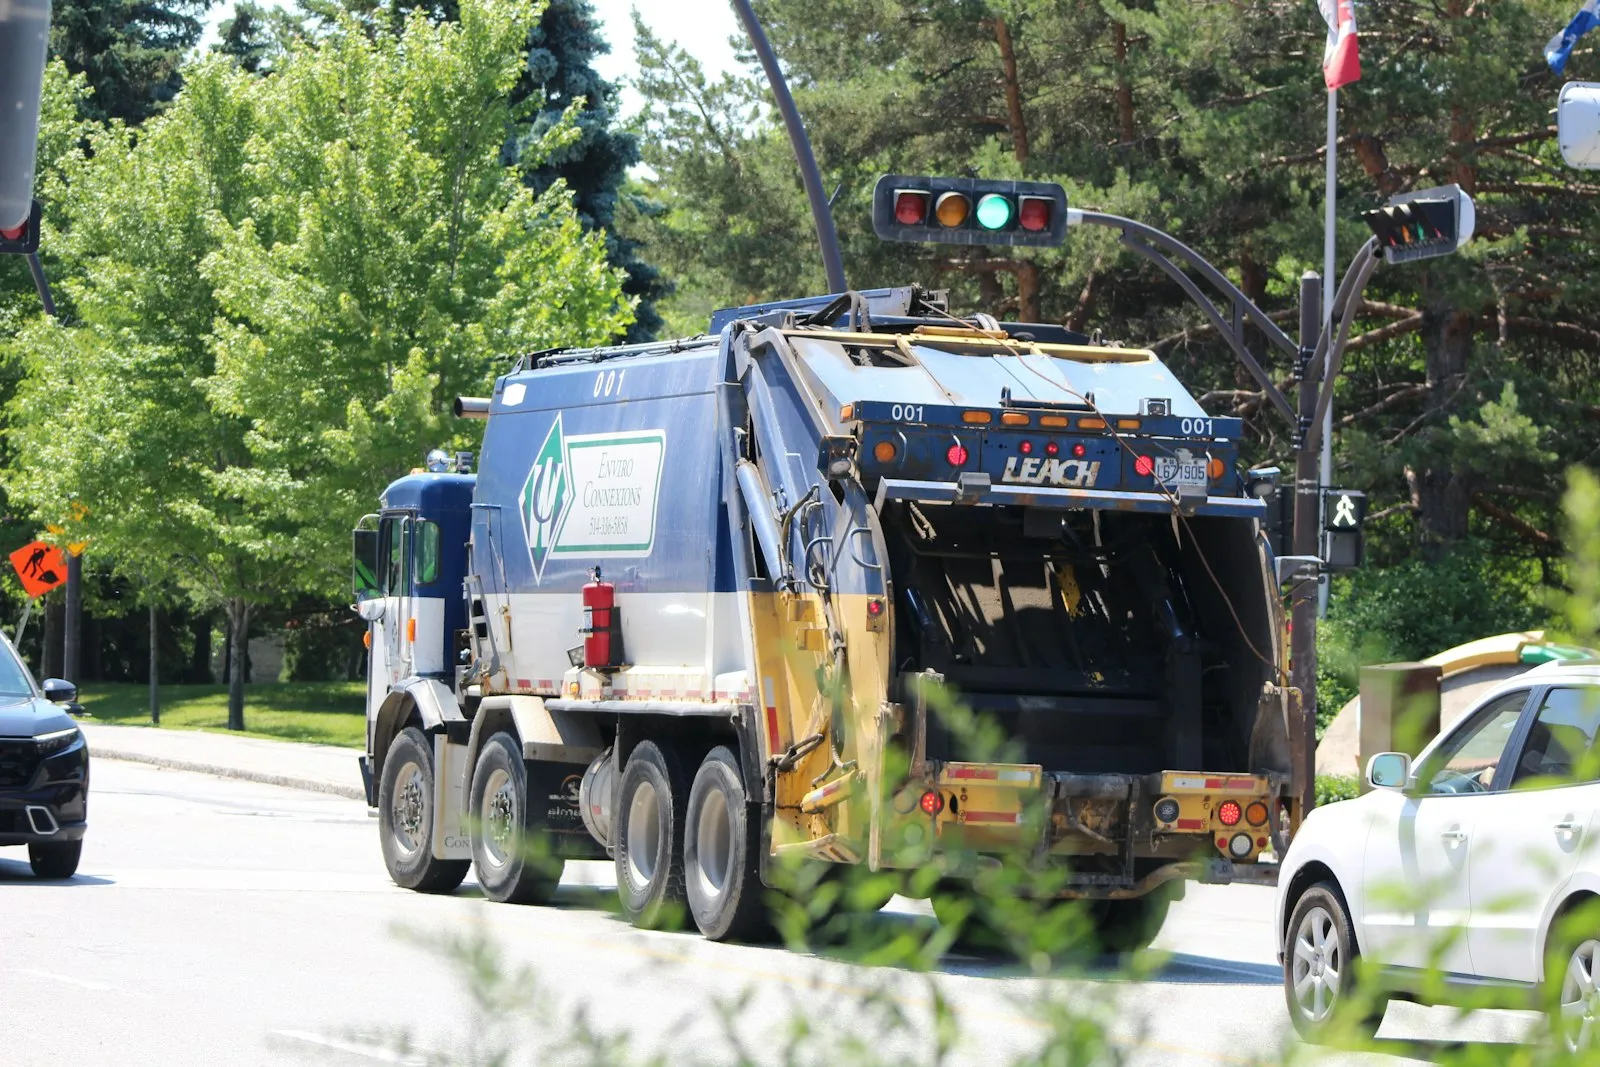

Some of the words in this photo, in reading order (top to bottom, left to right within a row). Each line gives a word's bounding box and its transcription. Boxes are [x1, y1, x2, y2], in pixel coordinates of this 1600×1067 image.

[593, 369, 626, 399] 001
[891, 404, 923, 422] 001
[1181, 418, 1212, 435] 001
[1002, 456, 1100, 487] LEACH
[1157, 464, 1205, 480] L671905
